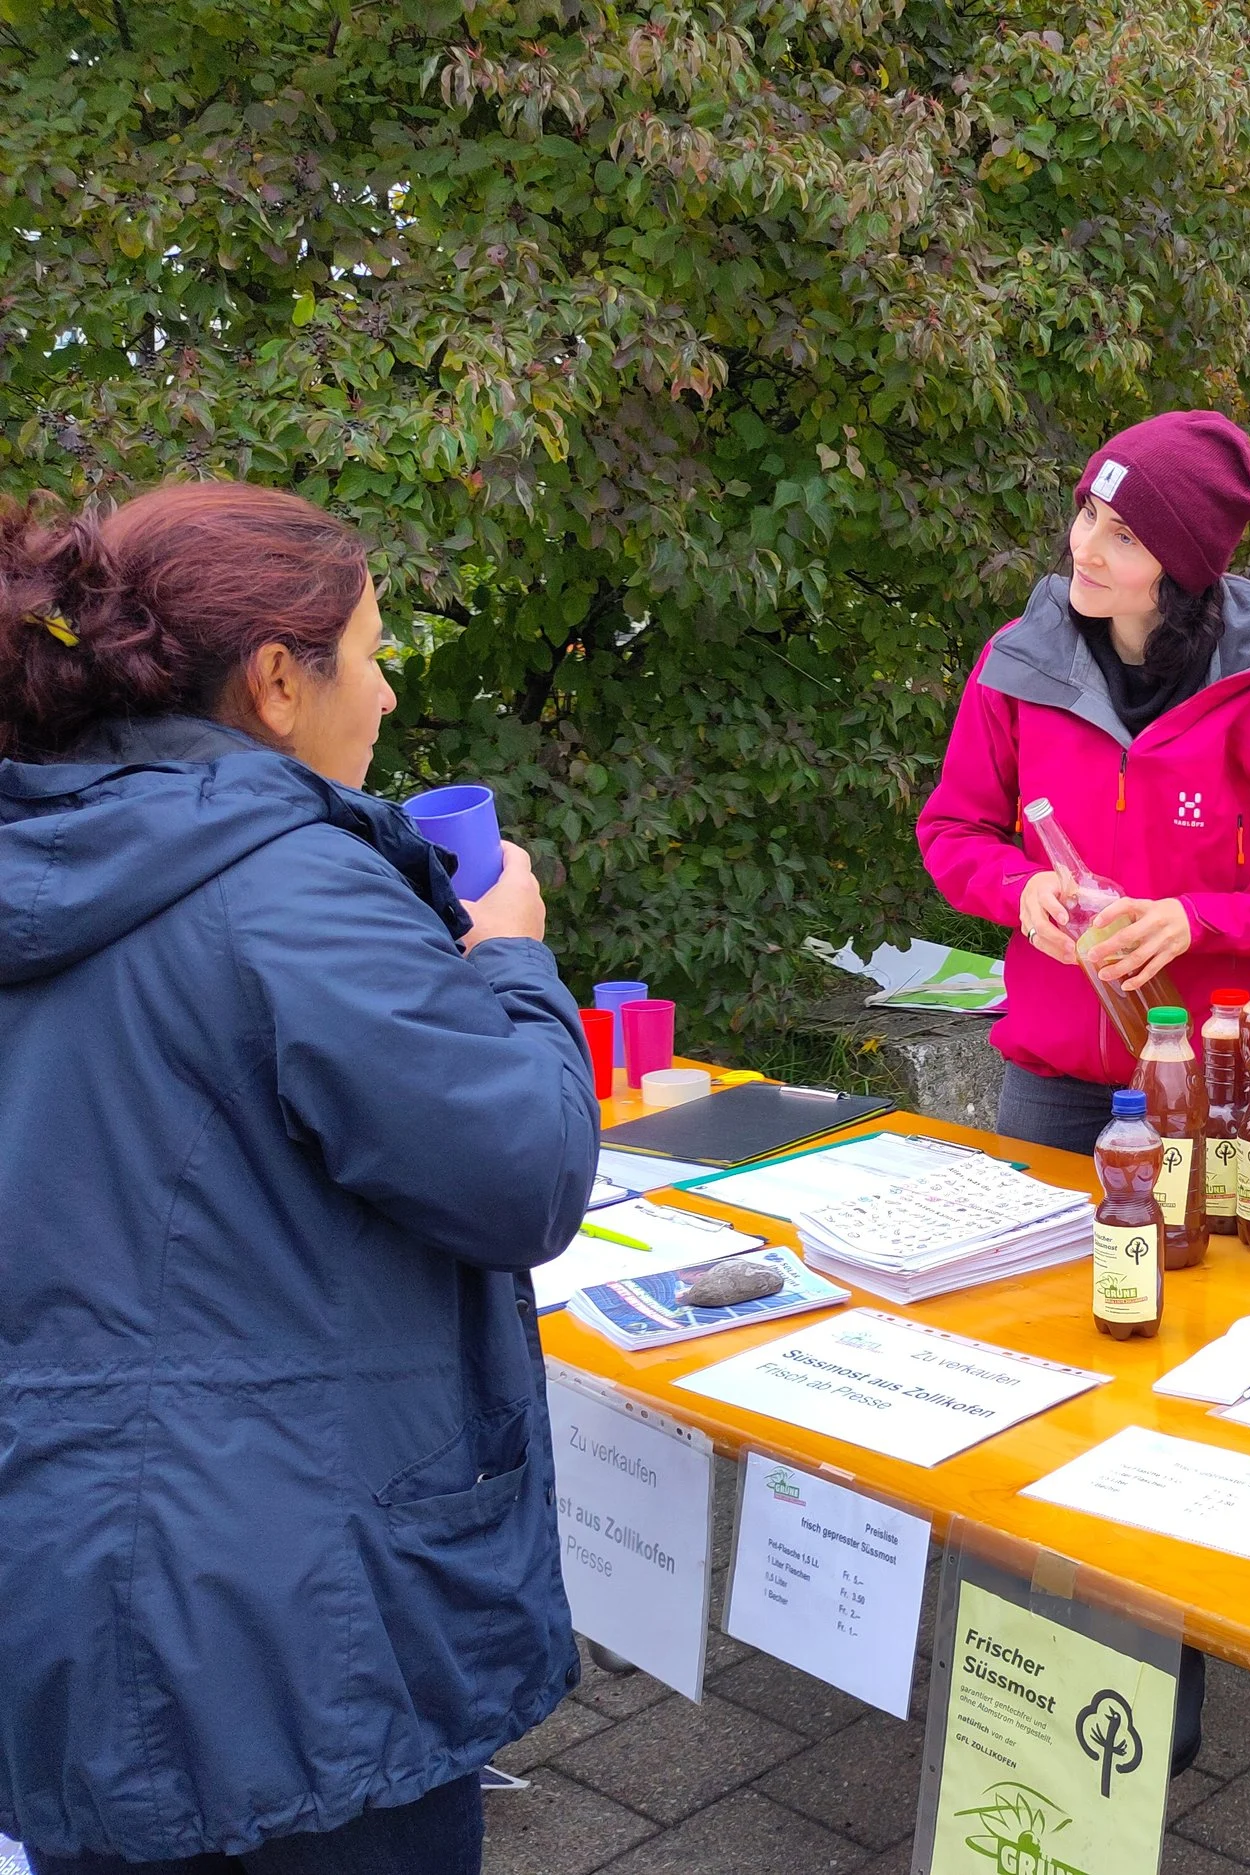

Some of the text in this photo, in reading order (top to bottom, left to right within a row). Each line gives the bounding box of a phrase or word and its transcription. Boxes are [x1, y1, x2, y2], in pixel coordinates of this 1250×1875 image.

[755, 1362, 893, 1411] Frisch ab Presse
[782, 1349, 996, 1419] Süssmost aus Zollikofen
[910, 1350, 1021, 1387] Zu verkaufen
[570, 1425, 656, 1488] Zu verkaufen
[567, 1535, 612, 1578] Presse
[576, 1506, 600, 1532] aus
[604, 1516, 675, 1574] Zollikofen
[801, 1517, 897, 1565] frisch gepresster Süssmost
[865, 1523, 898, 1546] Preisliste
[965, 1628, 1044, 1678] Frischer
[960, 1684, 1047, 1730] garantiert gentechfrei und
[963, 1655, 1056, 1714] Süssmost
[958, 1713, 1017, 1748] natürlich von der
[960, 1694, 976, 1707] ohne
[977, 1702, 1014, 1725] Atomstrom
[956, 1733, 1018, 1769] GFL ZOLLIKOFEN
